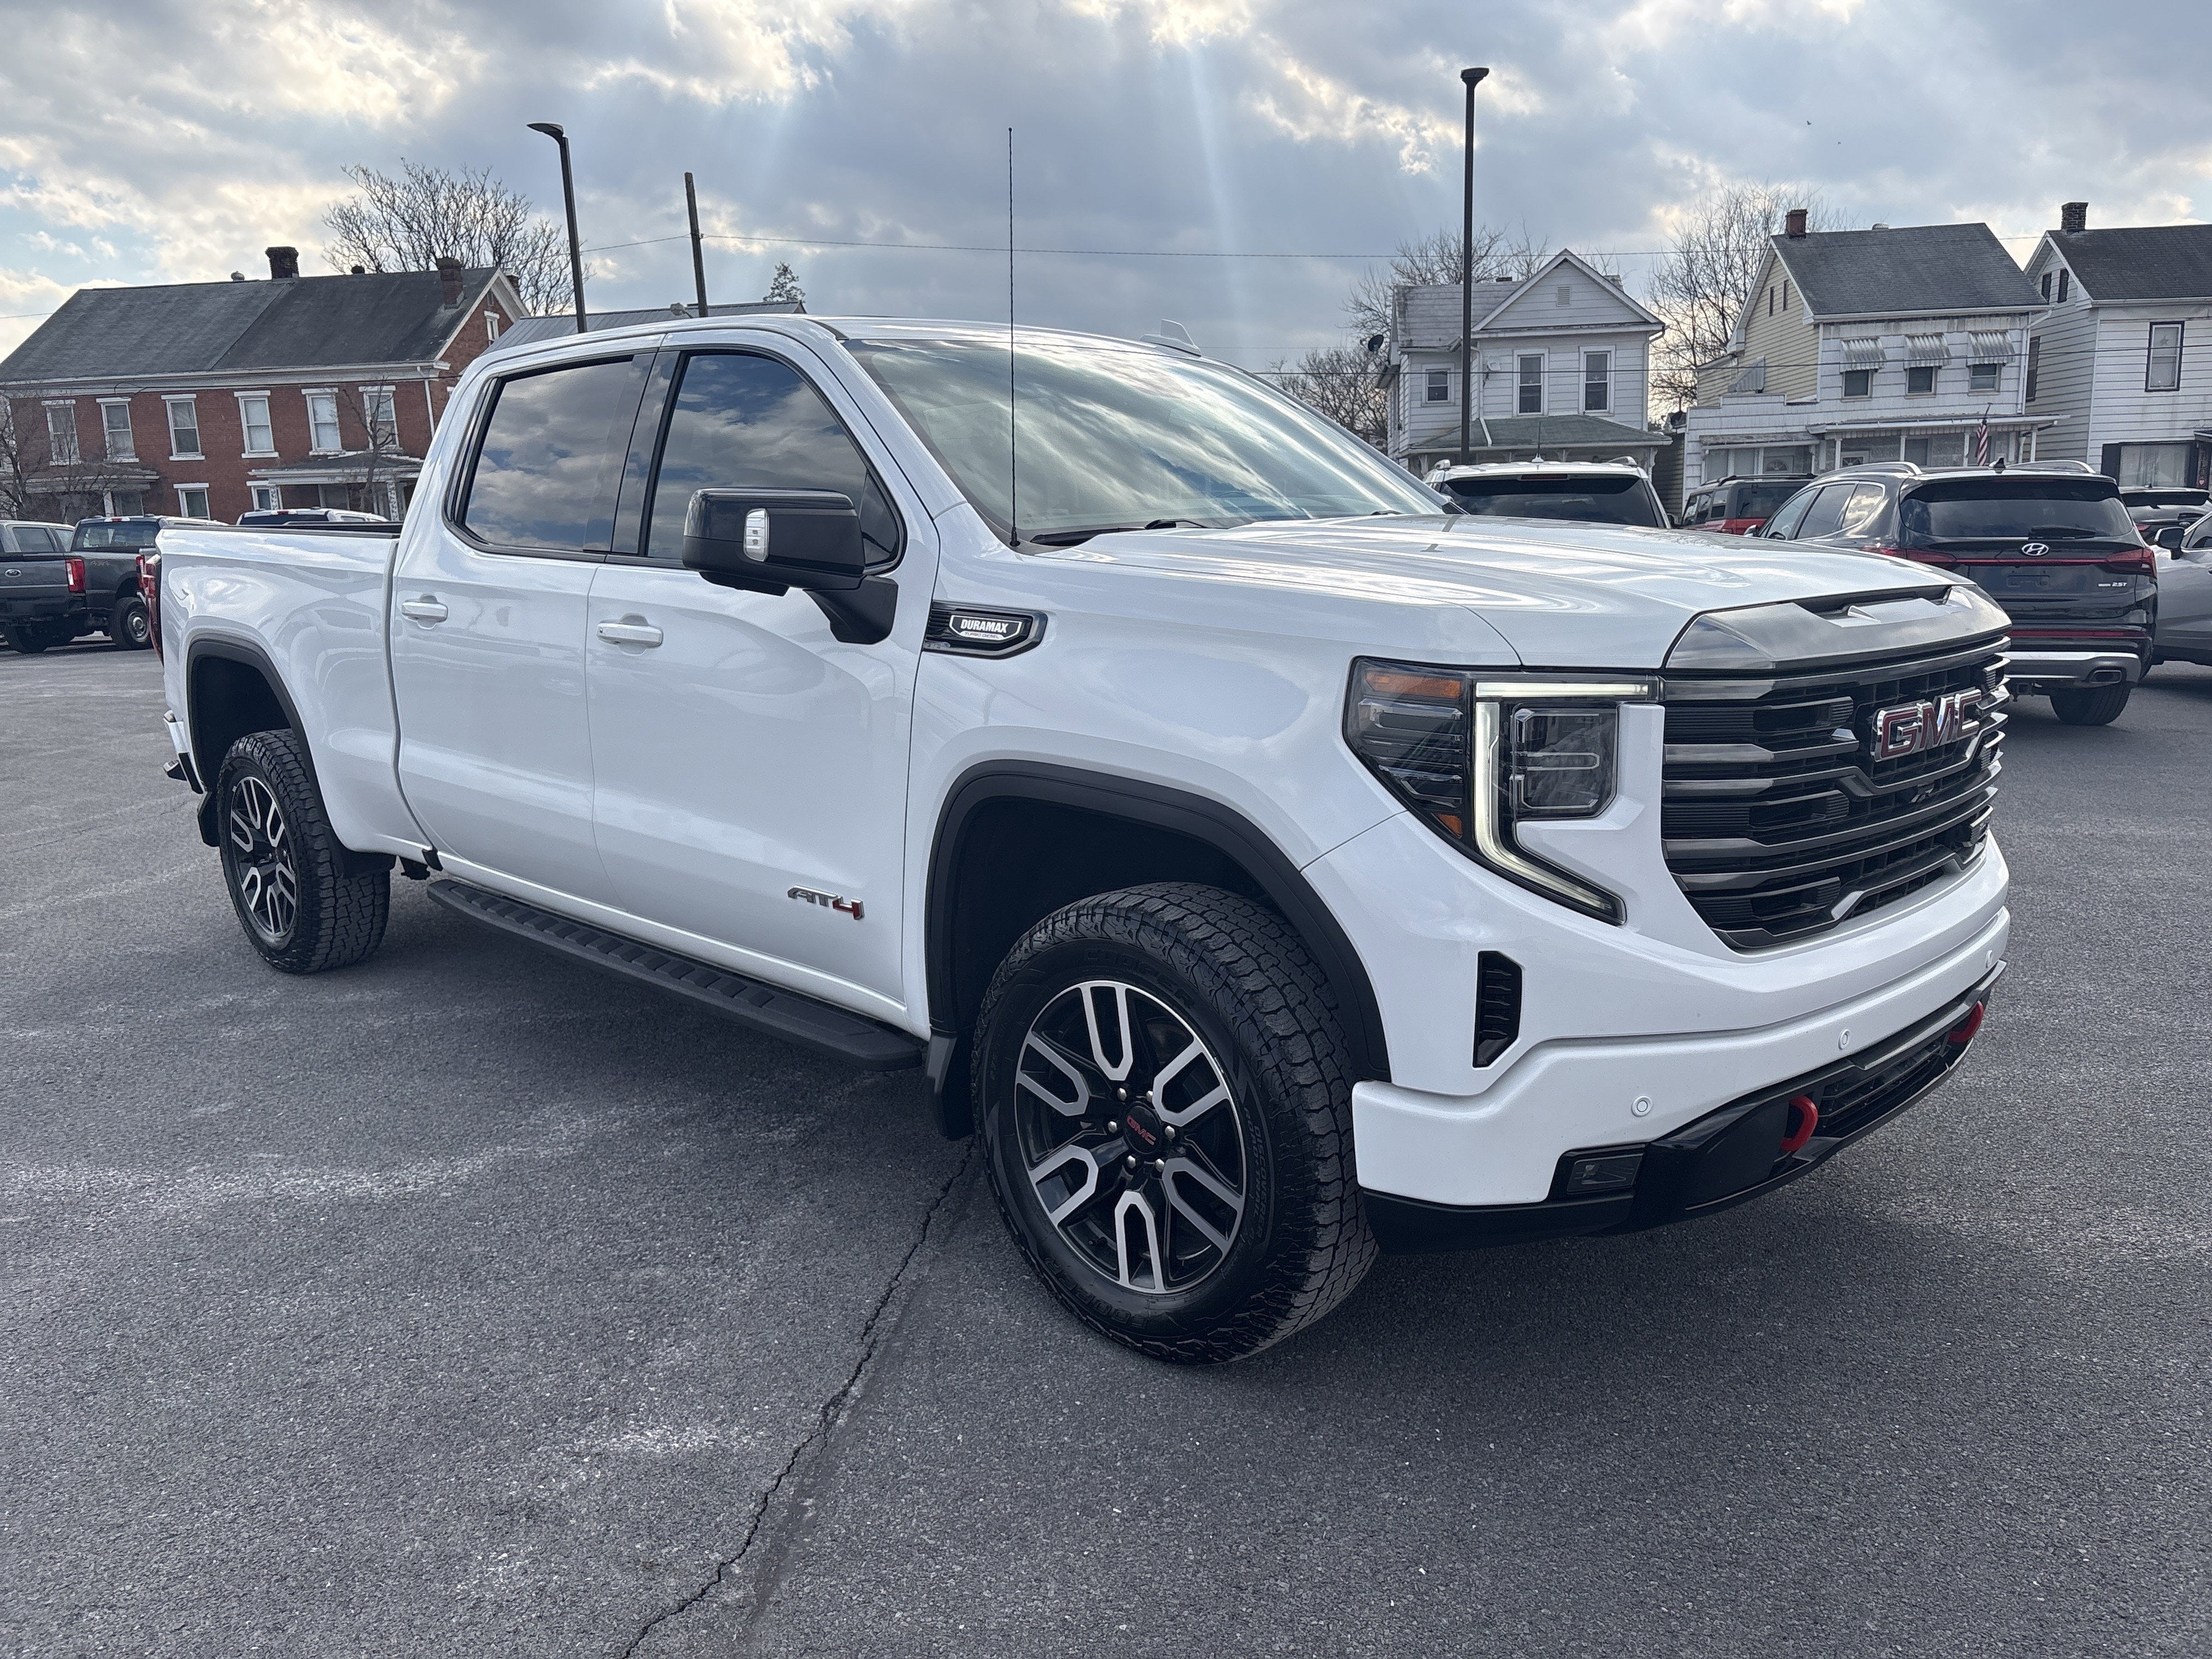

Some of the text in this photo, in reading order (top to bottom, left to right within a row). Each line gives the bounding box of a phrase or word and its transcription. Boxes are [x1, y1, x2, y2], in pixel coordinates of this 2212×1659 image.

[960, 619, 1009, 633] DURAMAX
[1871, 687, 1982, 763] GMC
[787, 884, 865, 920] AT4
[1126, 1115, 1156, 1146] GMC
